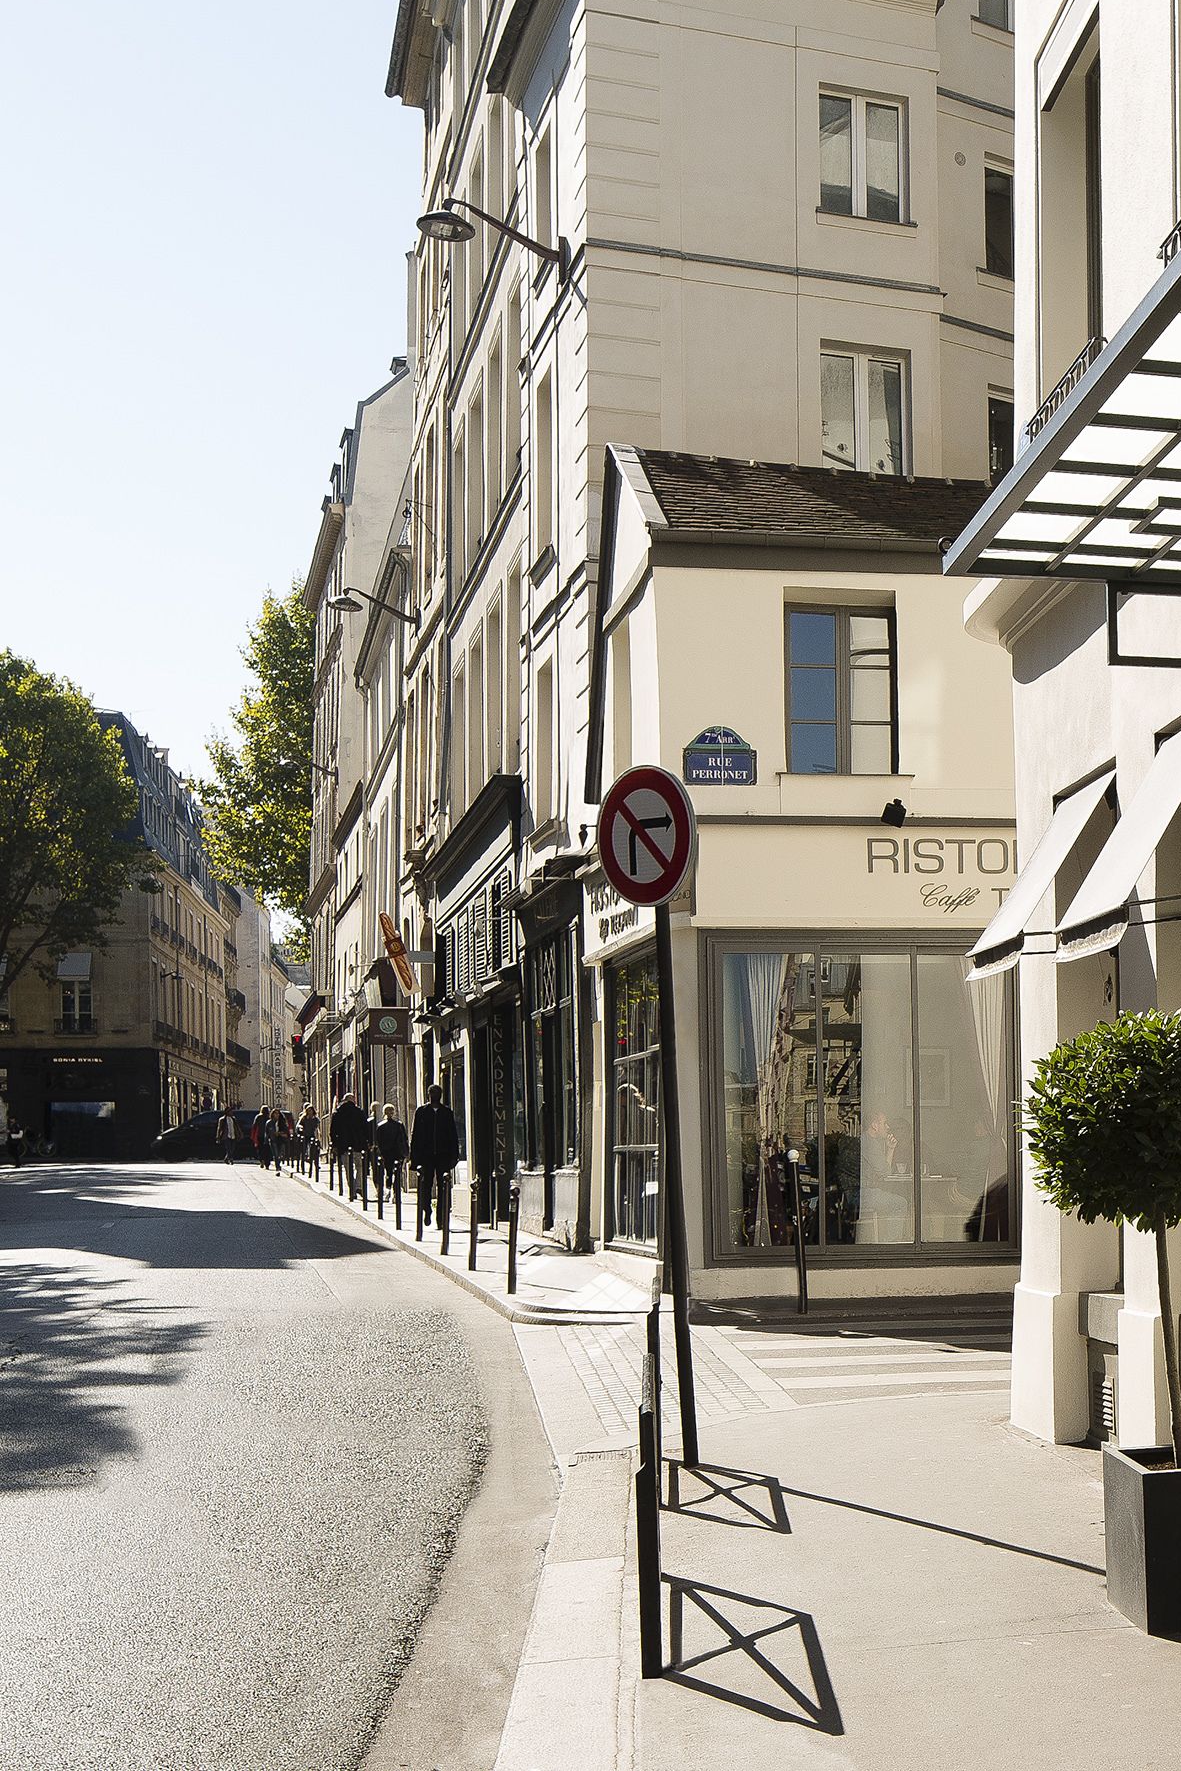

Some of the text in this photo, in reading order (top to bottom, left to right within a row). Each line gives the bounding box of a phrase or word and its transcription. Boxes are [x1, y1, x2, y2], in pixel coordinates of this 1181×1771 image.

[708, 757, 732, 766] RUE
[692, 770, 748, 779] PERRONET
[866, 838, 1018, 874] RISTO
[493, 1014, 507, 1176] ENCADREMENTS
